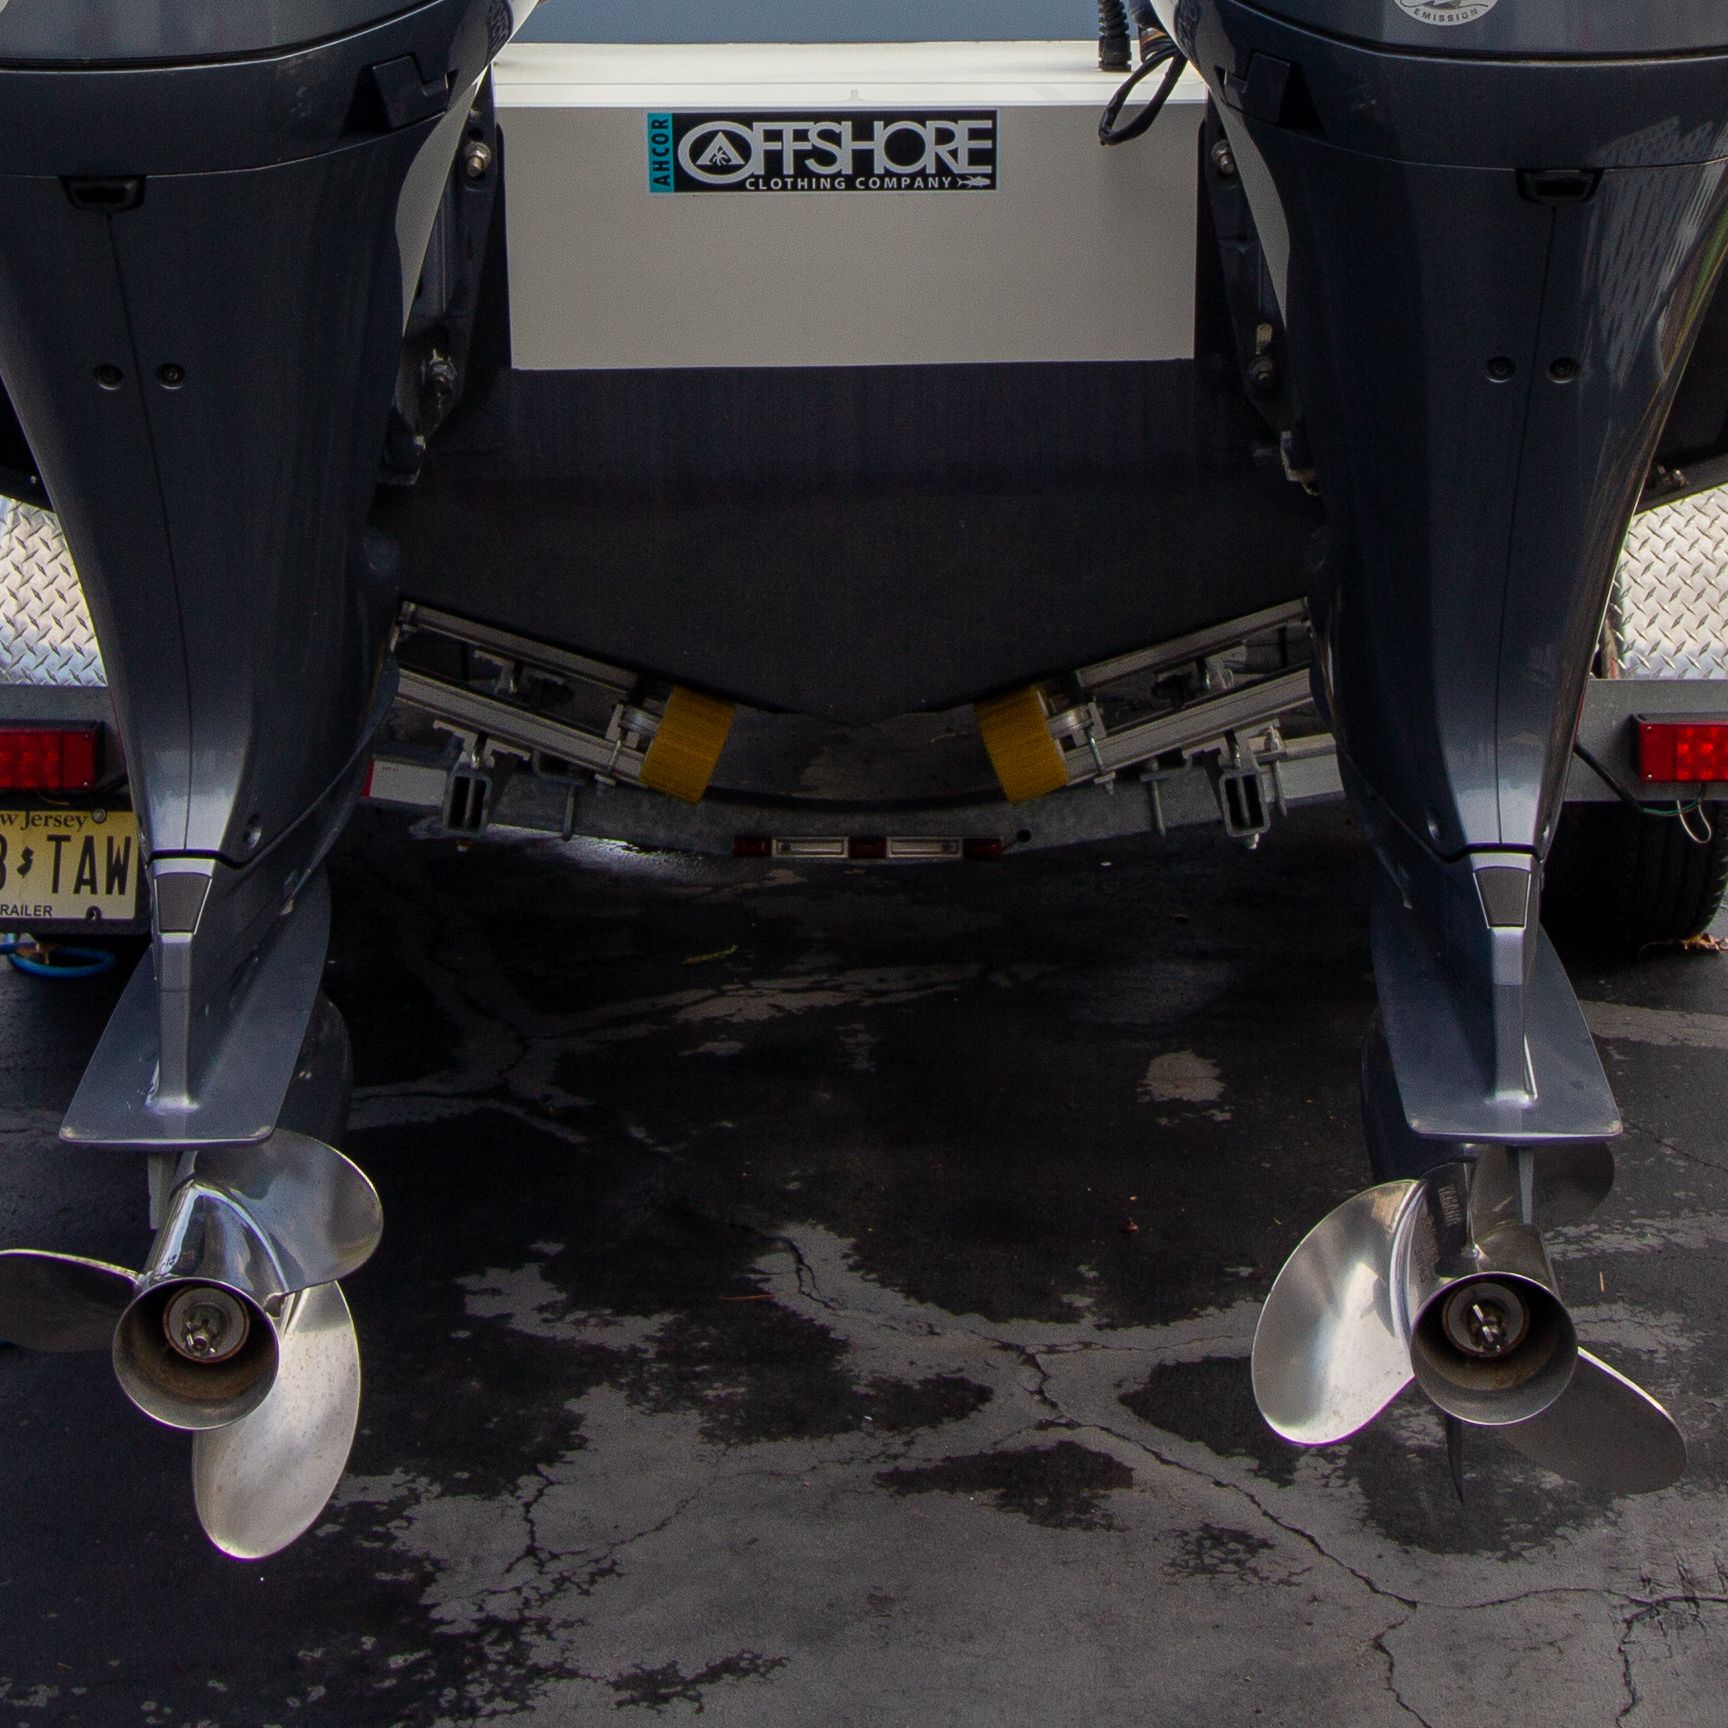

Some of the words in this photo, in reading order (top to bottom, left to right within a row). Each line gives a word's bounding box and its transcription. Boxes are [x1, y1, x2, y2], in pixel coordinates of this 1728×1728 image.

[1414, 7, 1479, 22] EMISSION
[652, 117, 670, 187] AHCOR
[678, 120, 993, 184] OFFSHORE
[745, 177, 846, 190] CLOTHING
[856, 176, 952, 190] COMPANY
[21, 810, 89, 832] Jersey
[46, 834, 132, 896] TAW
